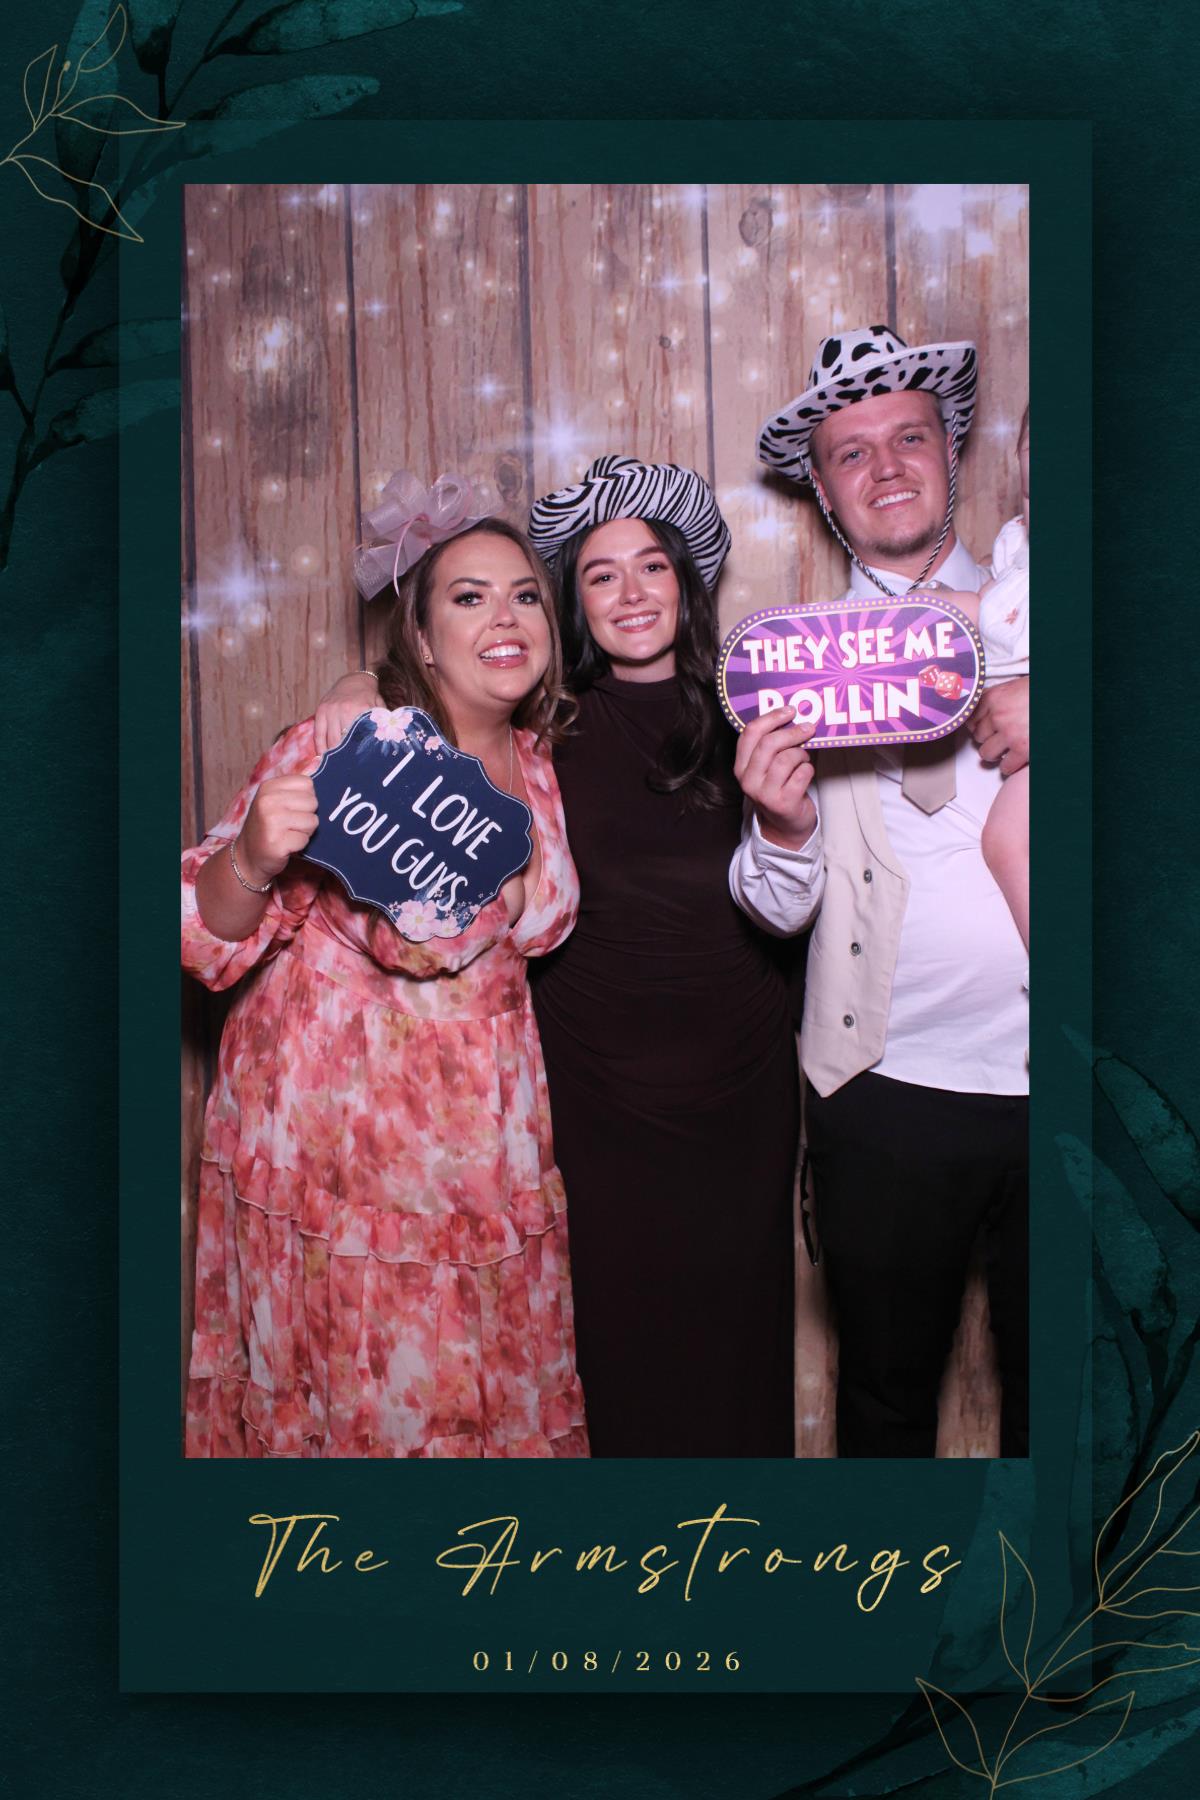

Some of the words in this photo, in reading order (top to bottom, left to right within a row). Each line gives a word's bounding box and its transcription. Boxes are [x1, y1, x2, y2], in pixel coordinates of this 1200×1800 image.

[743, 635, 830, 674] THEY
[838, 627, 895, 669] SEE
[903, 621, 955, 661] ME
[328, 786, 400, 854] YOU
[391, 838, 469, 911] GUYS
[382, 750, 415, 787] I
[412, 775, 503, 860] LOVE
